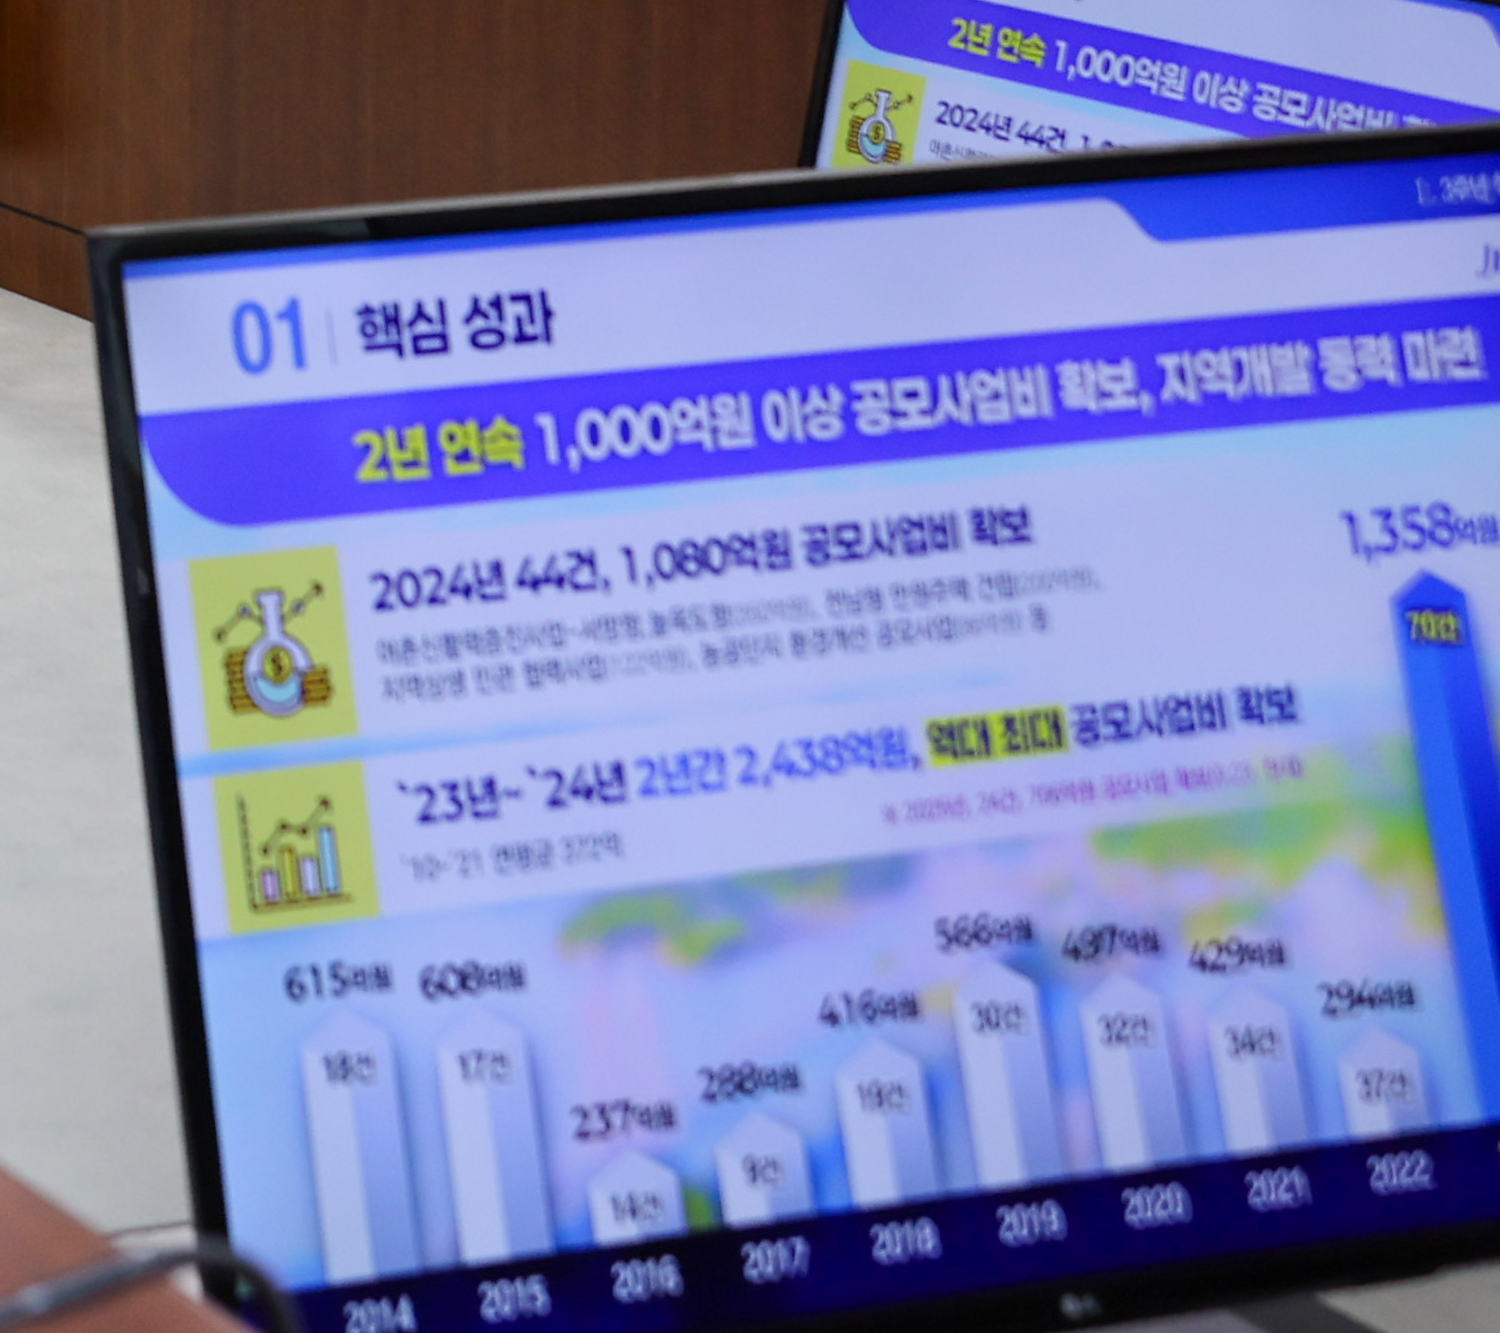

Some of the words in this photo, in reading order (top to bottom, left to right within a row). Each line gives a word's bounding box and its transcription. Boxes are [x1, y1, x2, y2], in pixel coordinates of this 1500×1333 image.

[946, 16, 990, 58] 2년
[997, 27, 1047, 69] 연속
[1052, 36, 1187, 103] 1,000억원
[1192, 67, 1249, 113] 이상
[932, 98, 1012, 145] 2024년
[231, 297, 308, 376] 01
[355, 298, 450, 360] 핵심
[463, 288, 556, 353] 성과
[351, 421, 432, 484] 2년
[438, 413, 526, 478] 연속
[534, 392, 757, 474] 1,000억원
[762, 383, 847, 444] 이상
[851, 360, 1054, 438] 공모사업비
[1058, 357, 1154, 416] 확보,
[1156, 341, 1315, 403] 지역개발
[1318, 333, 1401, 390] 동력
[1403, 324, 1486, 384] 마련
[370, 557, 506, 612] 2024년
[516, 547, 612, 595] 44건,
[619, 527, 794, 592] 1,080억원
[800, 508, 962, 567] 공모사업비
[969, 503, 1037, 547] 확보
[633, 747, 728, 799] 2년간
[1069, 689, 1230, 748] 공모사업비
[476, 1273, 552, 1323] 2015
[610, 1252, 685, 1305] 2016
[740, 1235, 812, 1285] 2017
[1121, 1180, 1194, 1229] 2020
[1244, 1163, 1312, 1212] 2021
[1366, 1147, 1437, 1196] 2022
